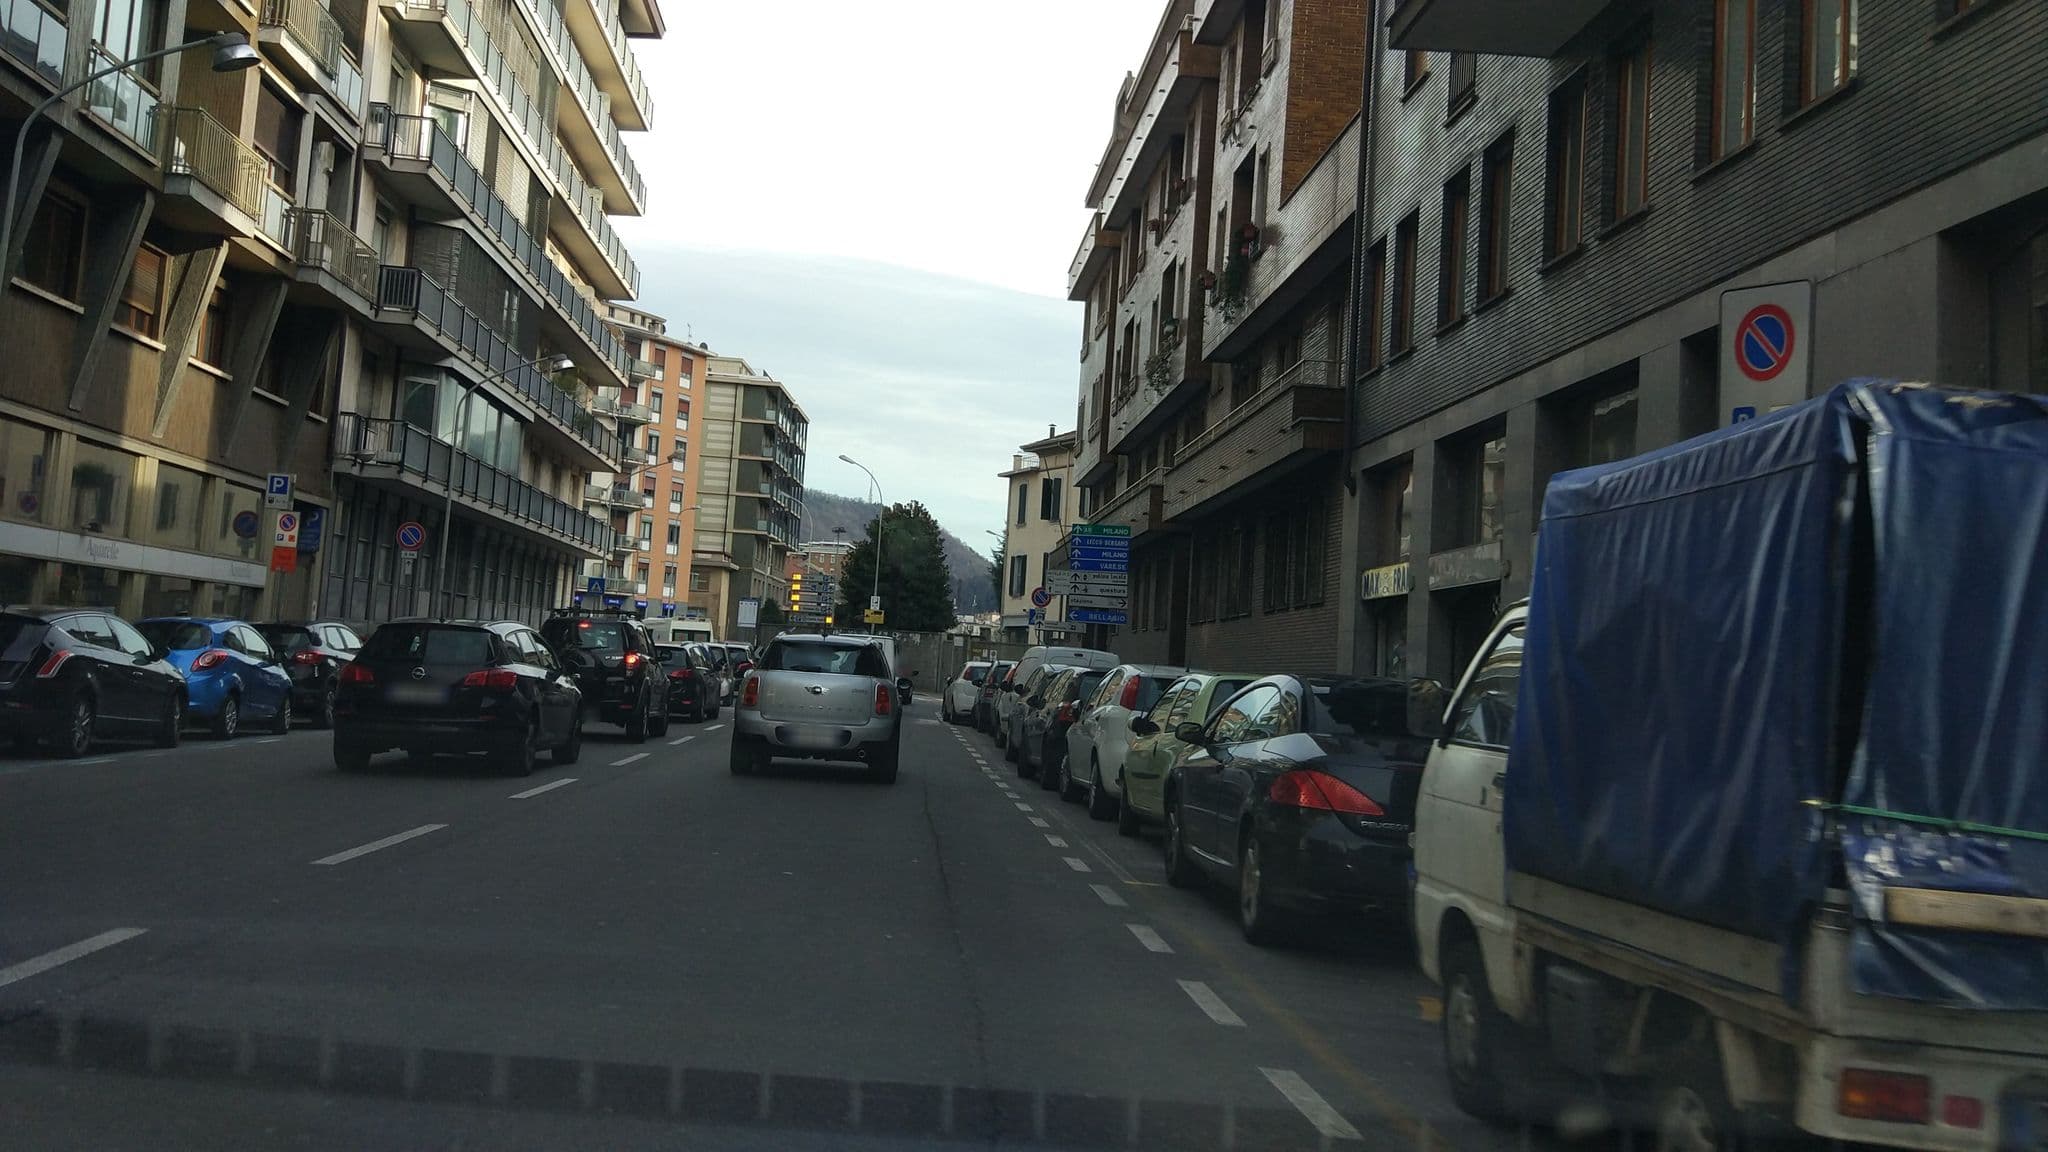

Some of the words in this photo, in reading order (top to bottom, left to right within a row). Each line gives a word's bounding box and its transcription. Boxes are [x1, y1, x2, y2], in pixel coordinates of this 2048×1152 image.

[272, 477, 285, 493] P
[1103, 527, 1129, 535] MILANO
[1088, 613, 1126, 622] BELLAGIO
[1360, 820, 1410, 832] PEUGEOT
